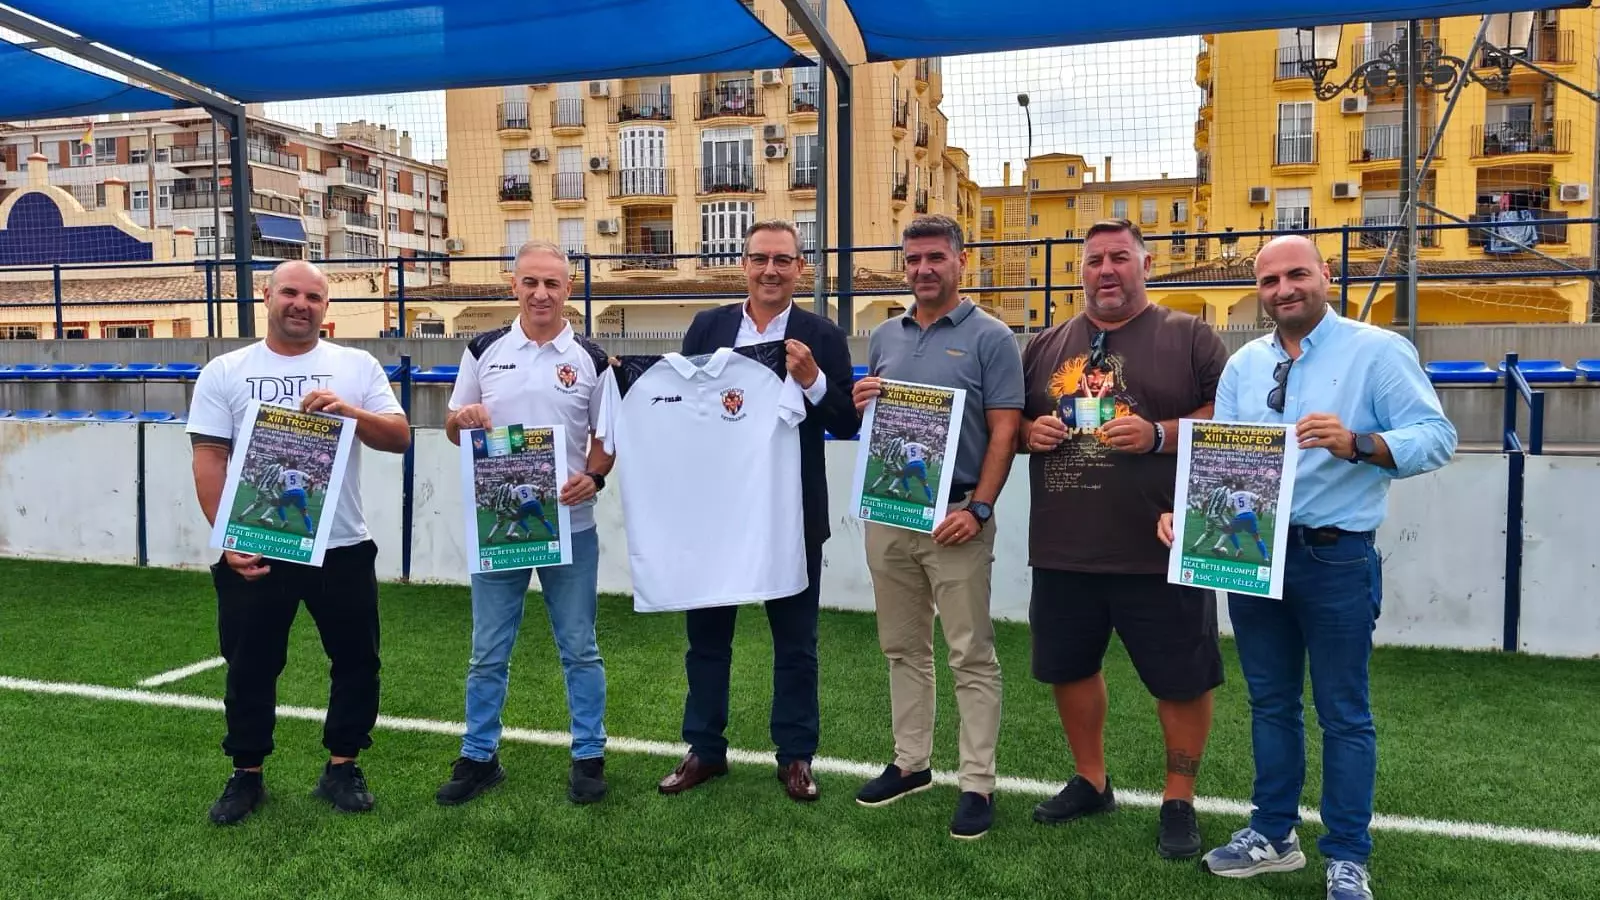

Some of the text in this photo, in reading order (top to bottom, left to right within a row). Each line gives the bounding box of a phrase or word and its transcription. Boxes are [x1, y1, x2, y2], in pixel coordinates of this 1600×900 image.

[887, 391, 943, 405] XIII TROFEO
[266, 414, 330, 433] XIII TROFEO
[1204, 433, 1272, 445] XIII TROFEO
[911, 447, 916, 456] 5
[289, 475, 296, 485] 5
[521, 489, 528, 498] 5
[862, 499, 876, 508] REAL
[1238, 496, 1245, 508] 5
[227, 527, 245, 537] REAL
[480, 549, 497, 557] REAL
[1183, 560, 1199, 569] REAL
[1200, 562, 1220, 571] BETIS
